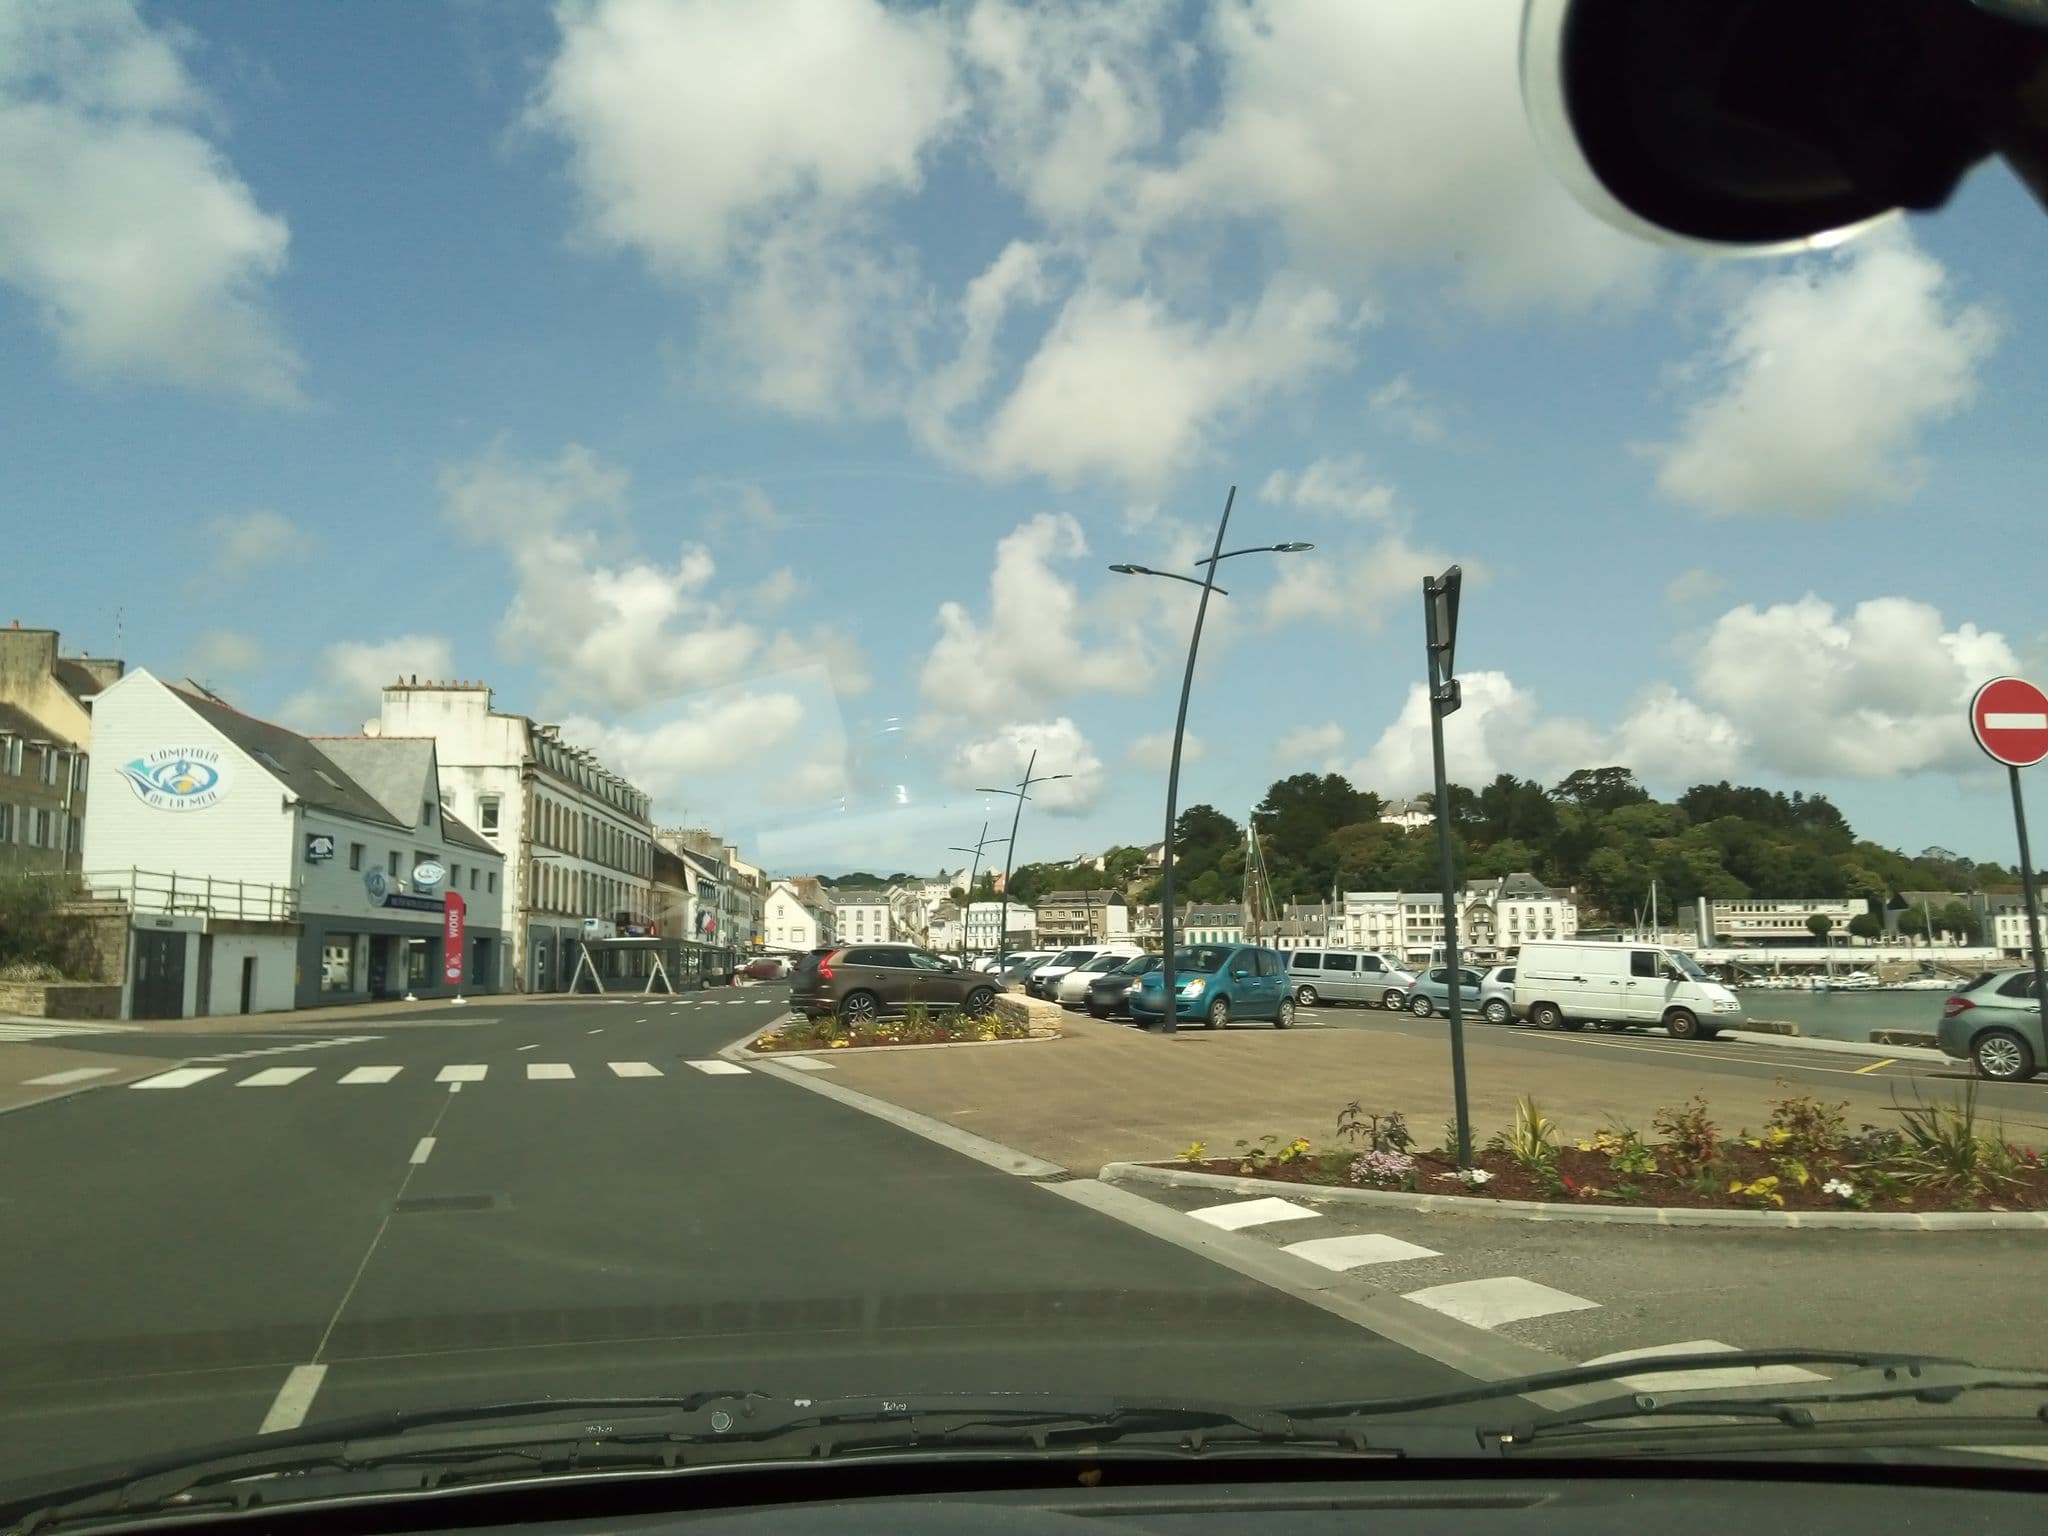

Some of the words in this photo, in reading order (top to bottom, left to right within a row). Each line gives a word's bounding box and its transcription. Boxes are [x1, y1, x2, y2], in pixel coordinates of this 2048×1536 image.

[151, 747, 219, 763] COMPTOIR
[150, 793, 162, 805] DE
[169, 799, 184, 808] LA
[190, 791, 217, 806] MER
